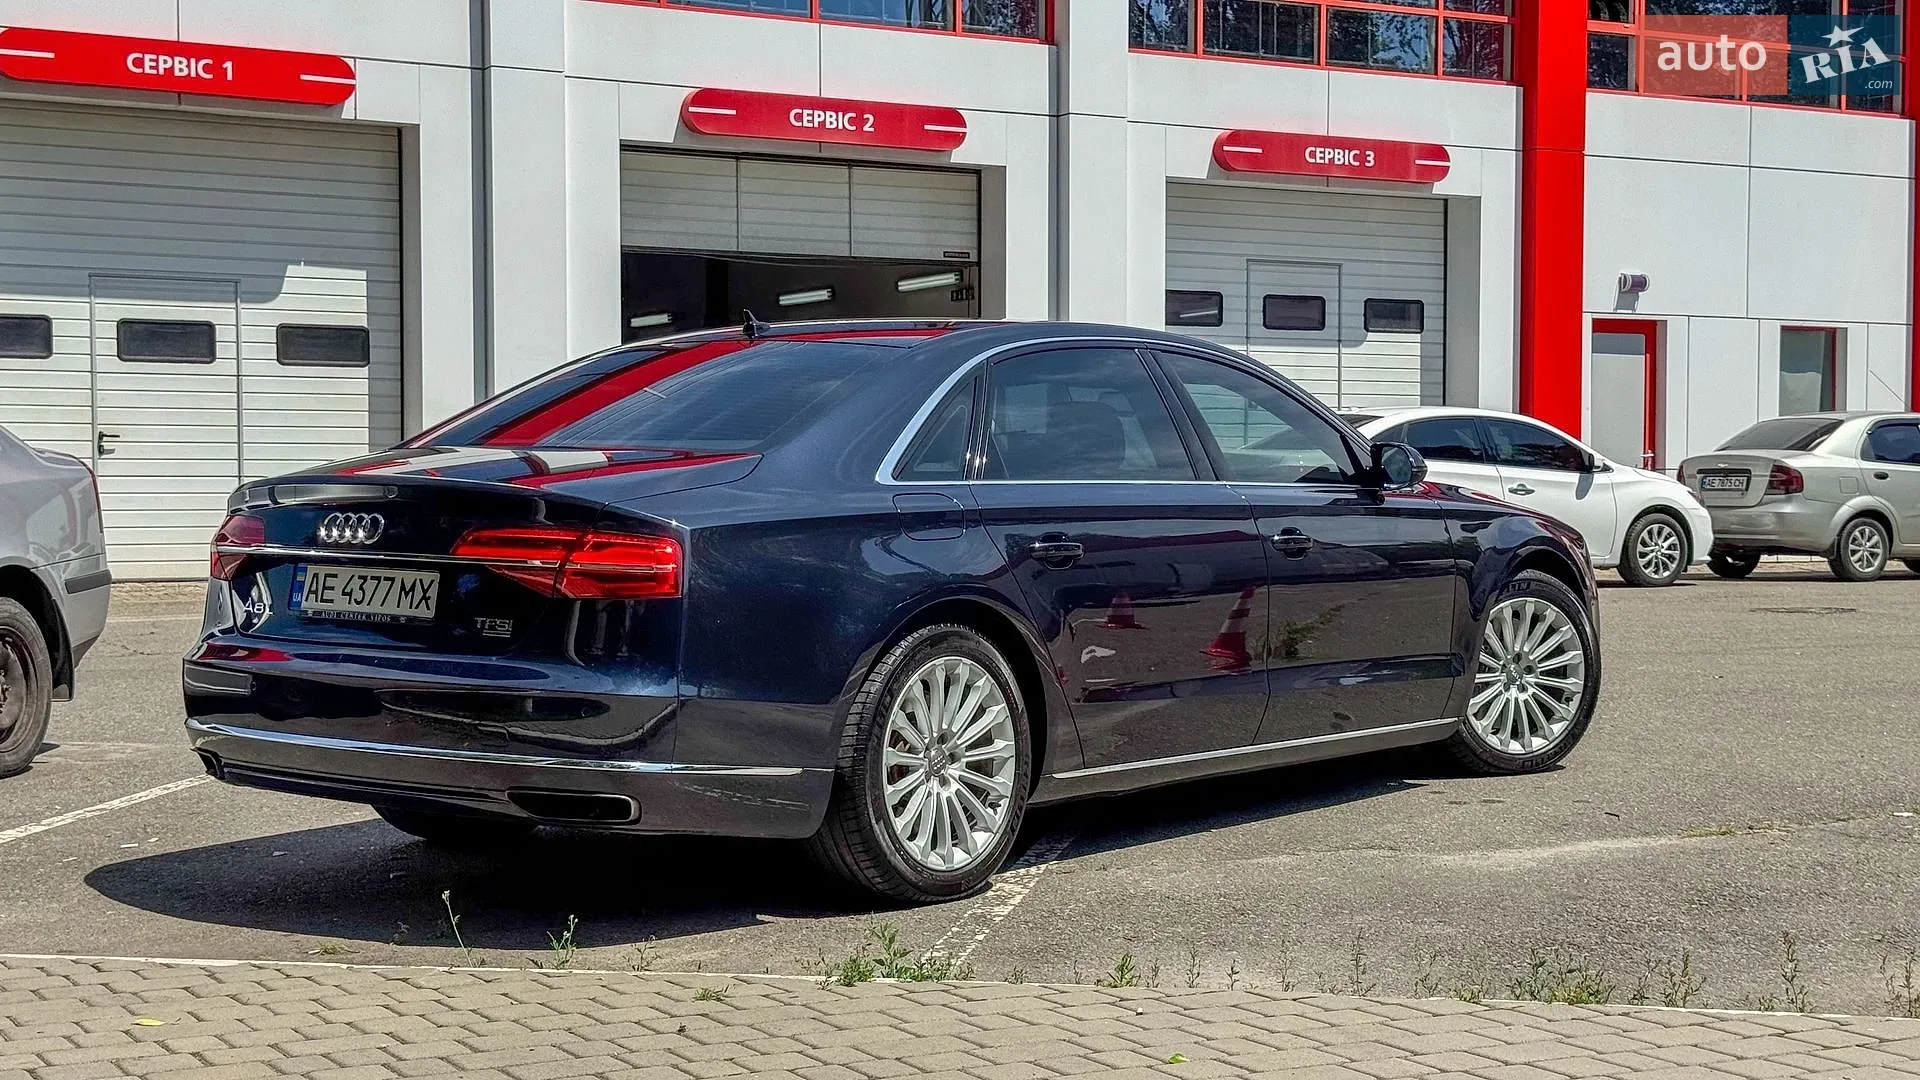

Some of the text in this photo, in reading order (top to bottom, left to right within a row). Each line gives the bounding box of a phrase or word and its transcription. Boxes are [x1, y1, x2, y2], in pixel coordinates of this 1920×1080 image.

[126, 52, 233, 81] СЕРВІС 1
[789, 108, 875, 132] СЕРВІС 2
[1304, 146, 1376, 168] СЕРВІС 3
[304, 572, 436, 611] AE 4377 MX
